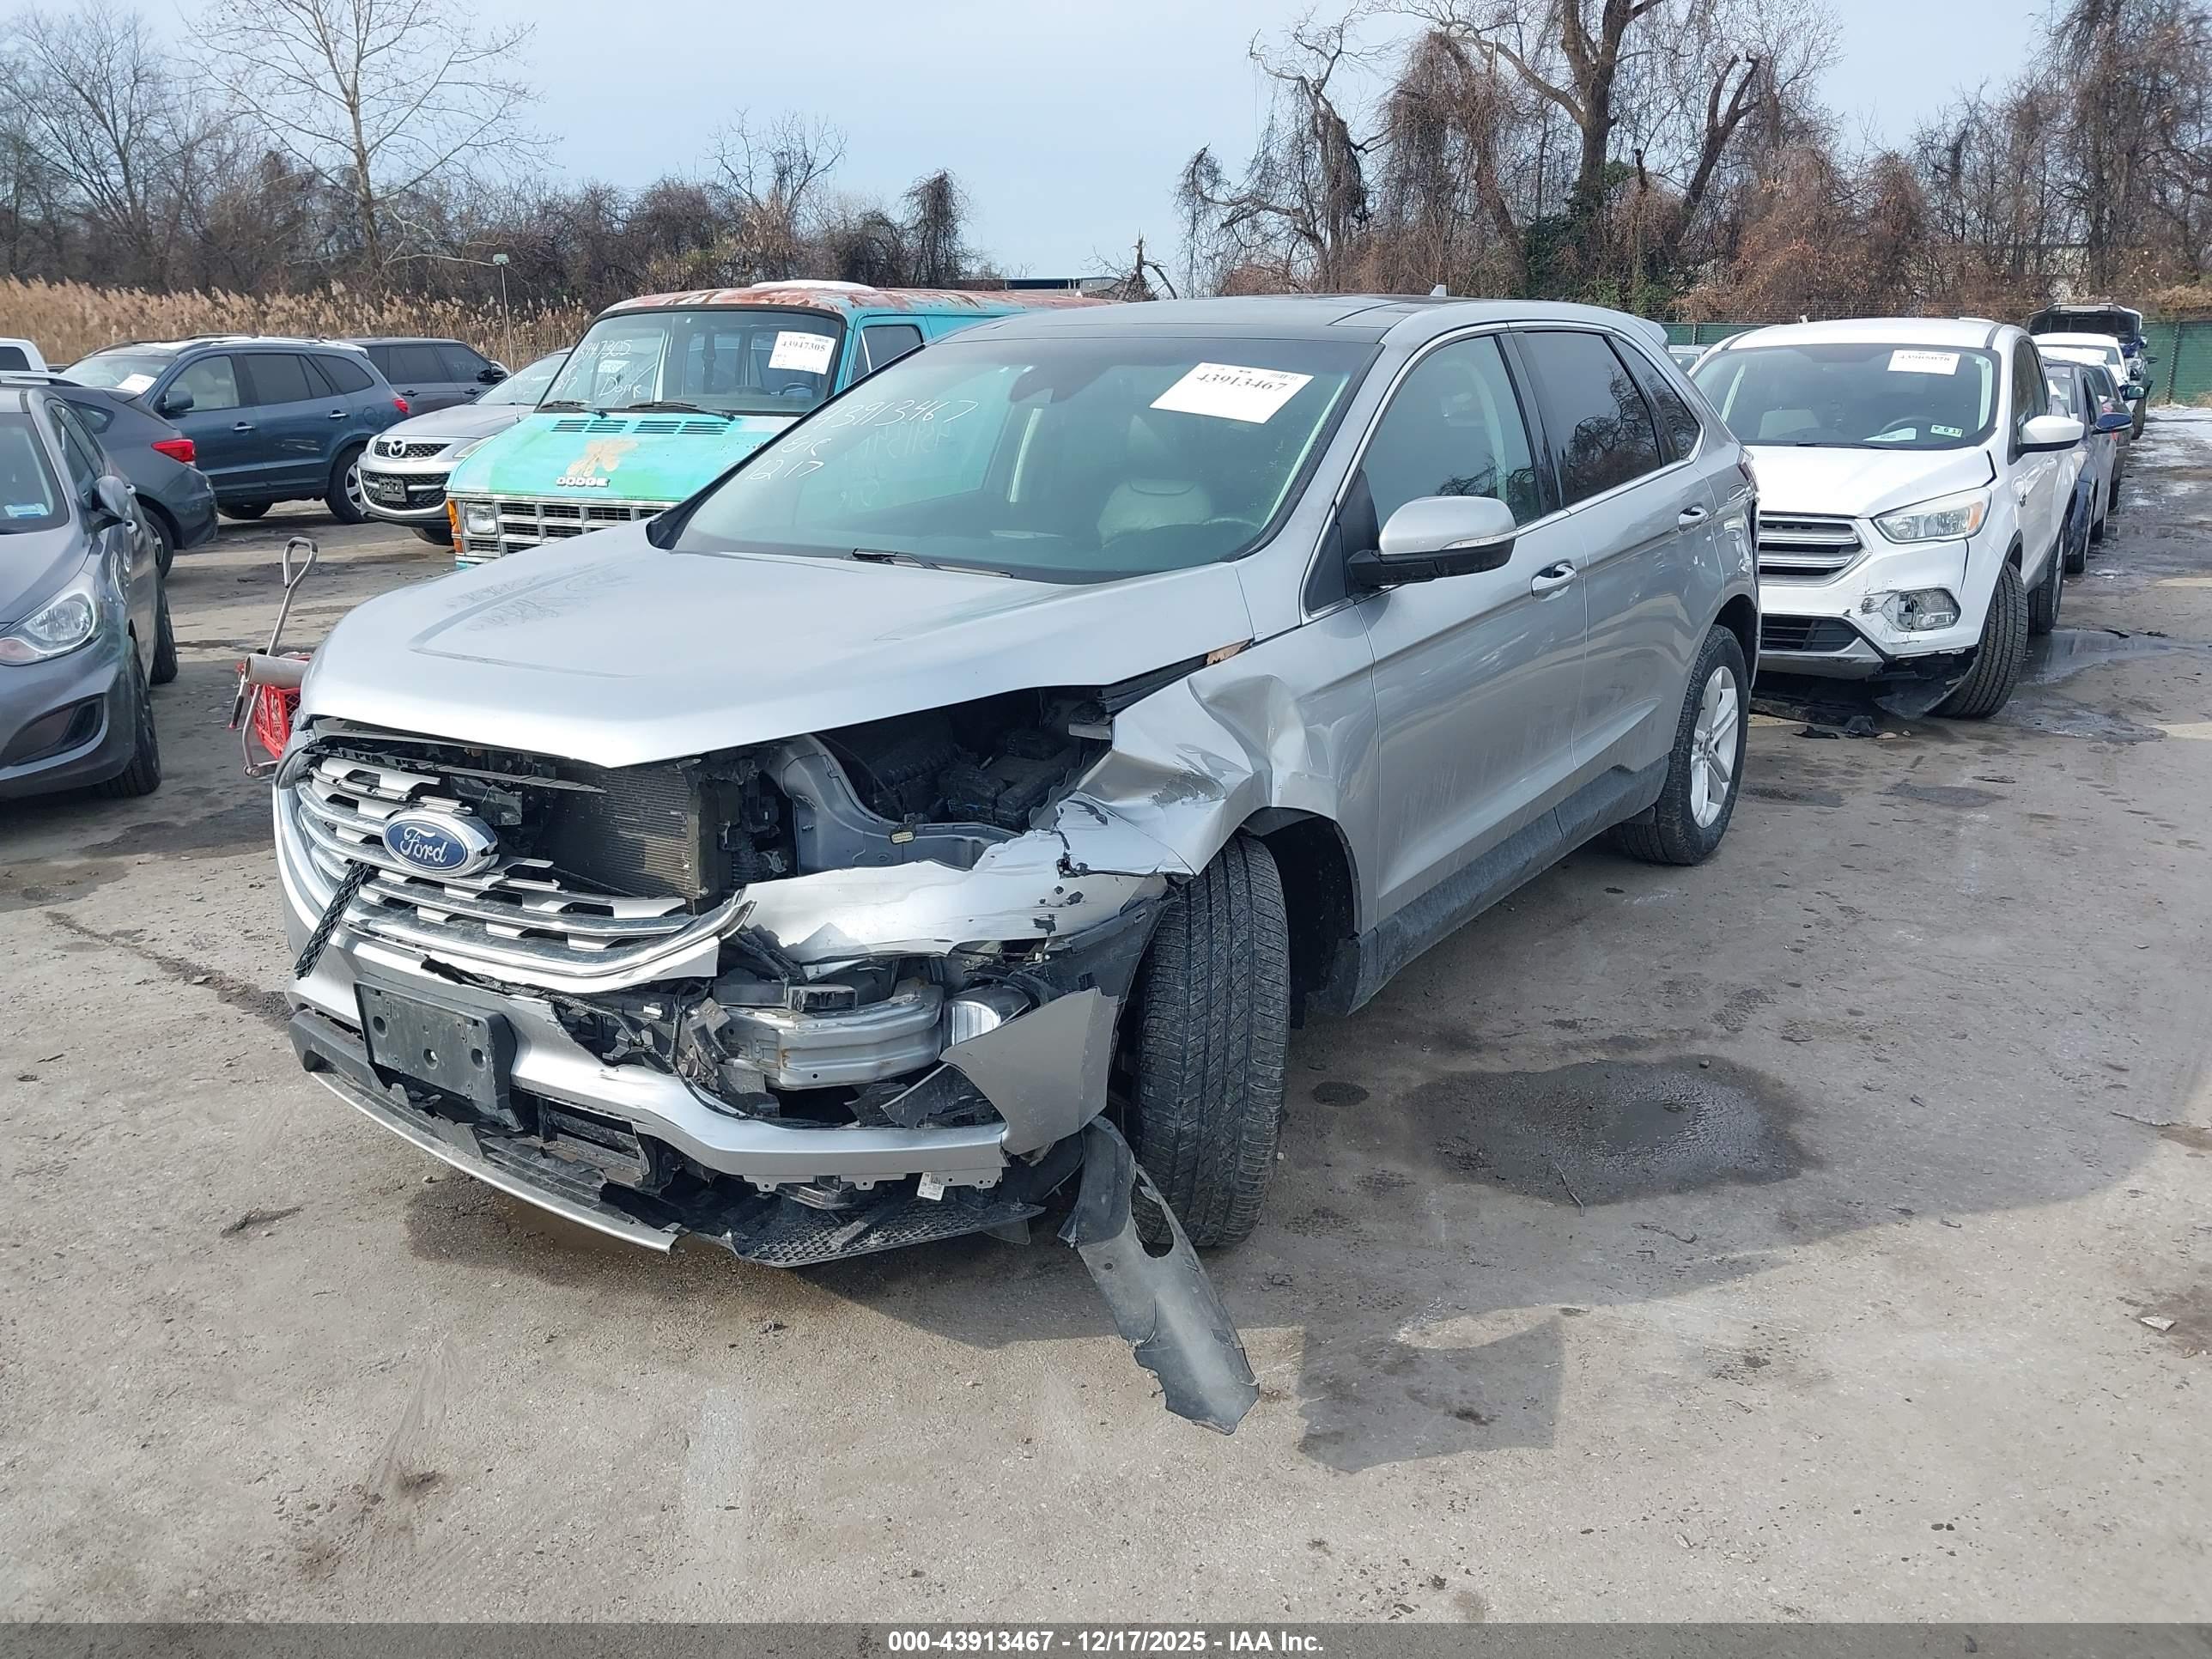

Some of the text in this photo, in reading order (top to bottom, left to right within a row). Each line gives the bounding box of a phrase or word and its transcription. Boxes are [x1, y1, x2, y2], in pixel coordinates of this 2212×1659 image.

[1196, 373, 1288, 392] 43913467
[813, 399, 980, 429] 43913467
[744, 459, 824, 480] 1217
[556, 477, 611, 488] DODGE
[399, 826, 448, 863] Ford
